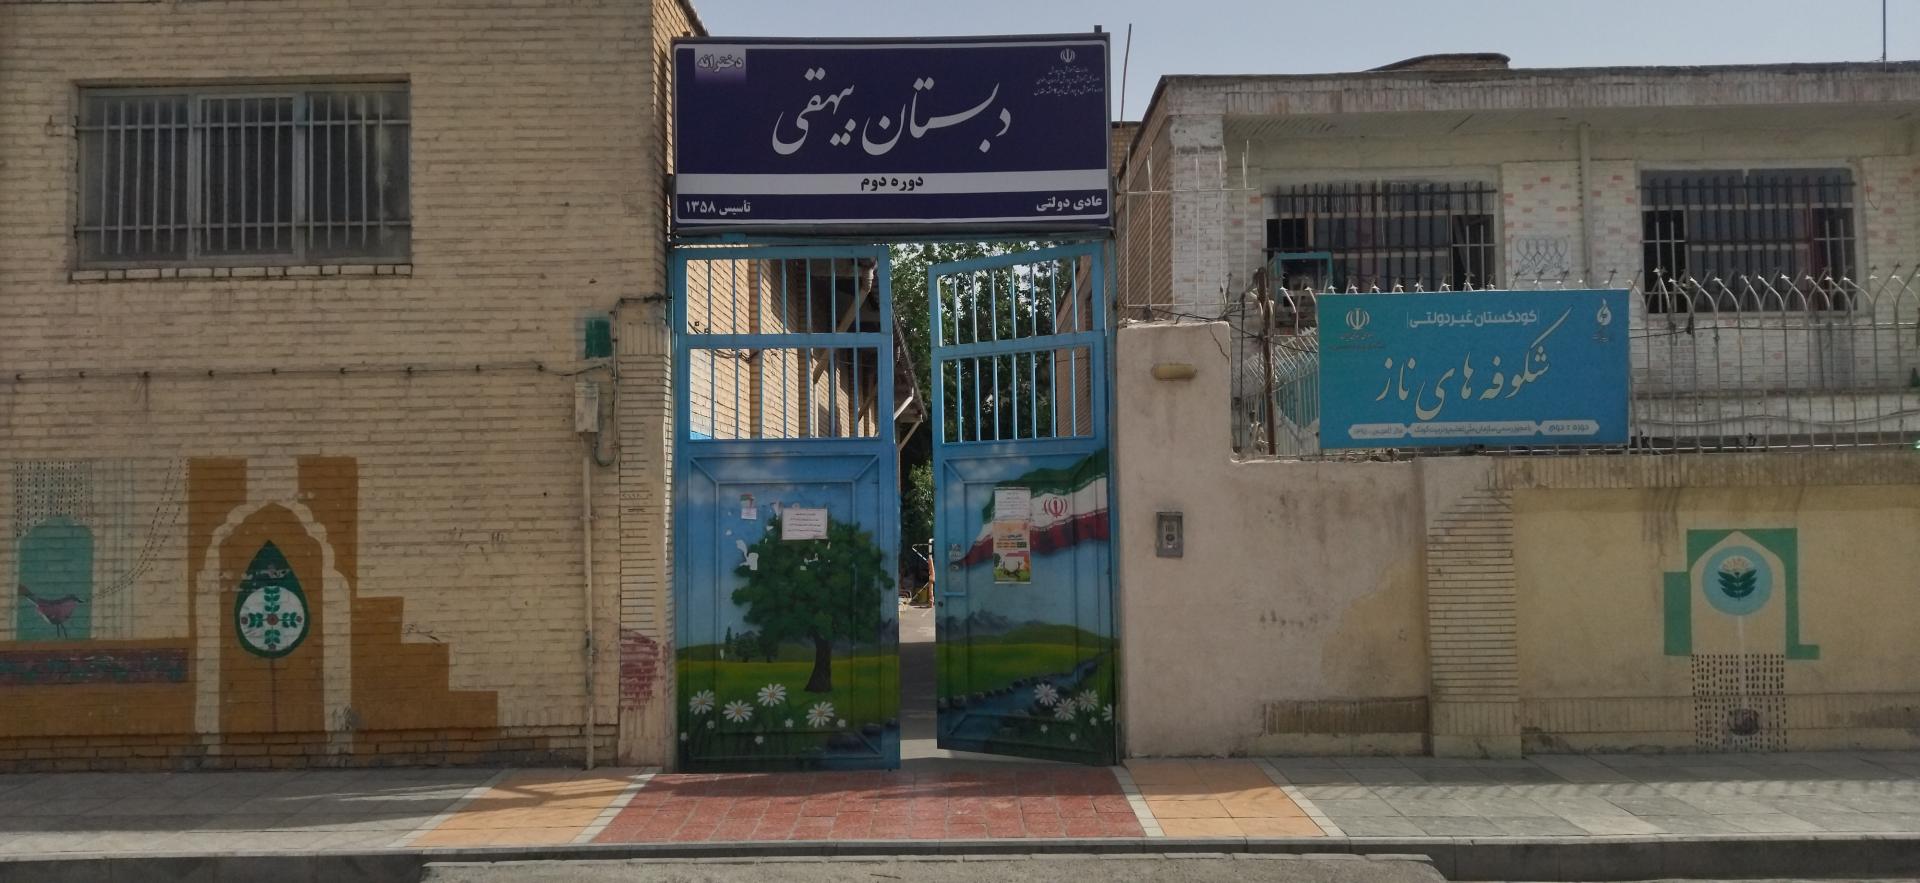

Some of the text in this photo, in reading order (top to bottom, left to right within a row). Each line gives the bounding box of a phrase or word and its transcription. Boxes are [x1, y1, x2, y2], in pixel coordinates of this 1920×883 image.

[697, 54, 744, 73] دخترانه
[772, 67, 1012, 156] دبستان بیهقی
[860, 174, 924, 192] دوره دوم
[686, 201, 716, 213] ۱۳۵۸
[1036, 195, 1103, 212] عادی دولتی
[1474, 310, 1537, 327] کودکستان
[1375, 306, 1574, 421] شکوفه های ناز
